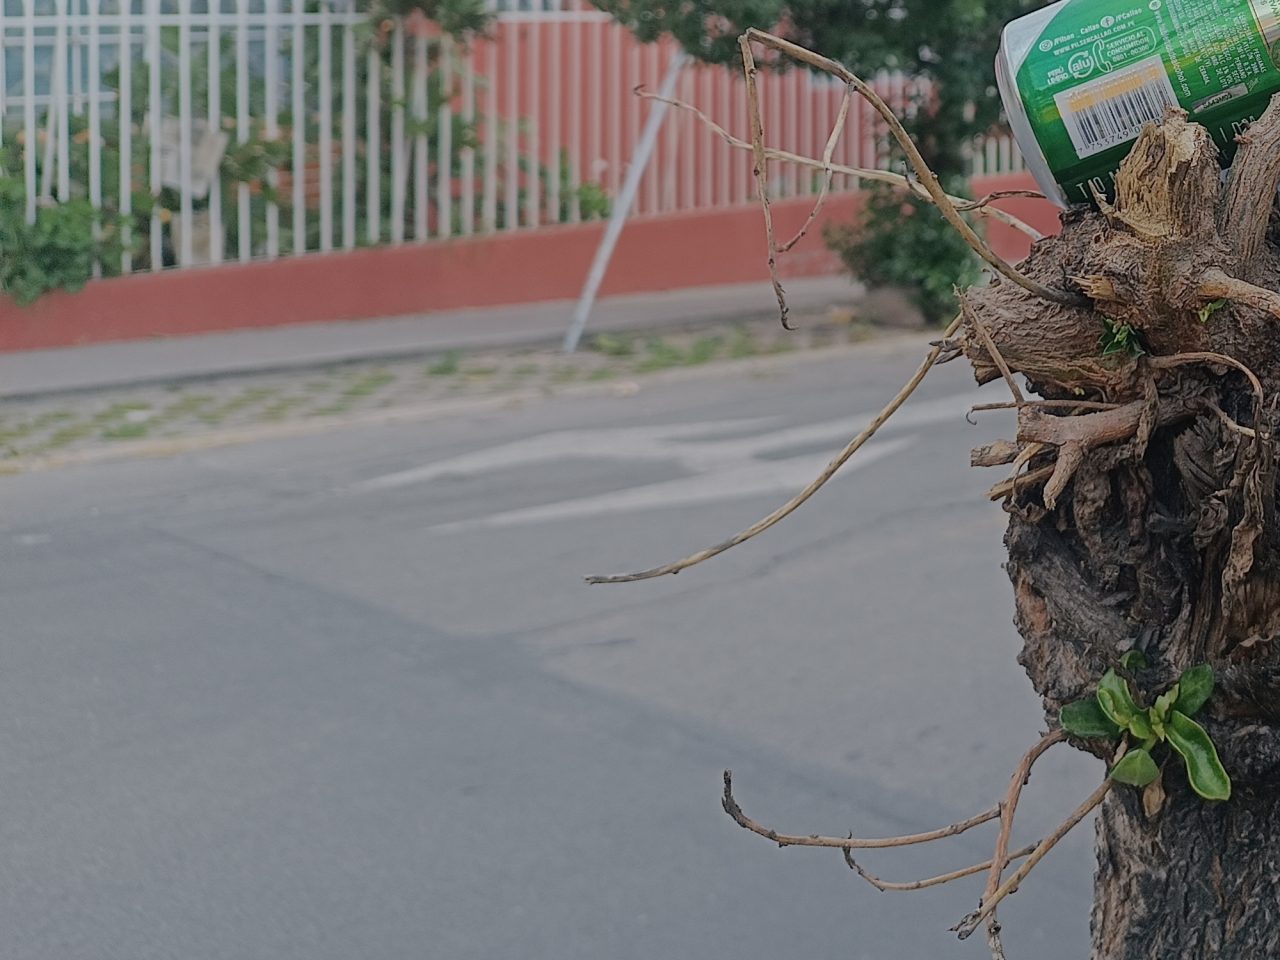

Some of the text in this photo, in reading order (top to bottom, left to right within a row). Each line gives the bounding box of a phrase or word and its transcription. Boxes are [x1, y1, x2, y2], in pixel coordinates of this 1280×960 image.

[1105, 29, 1146, 50] SERVICIO AL
[1105, 35, 1149, 57] CONSUMIDOR
[1070, 56, 1091, 72] alu
